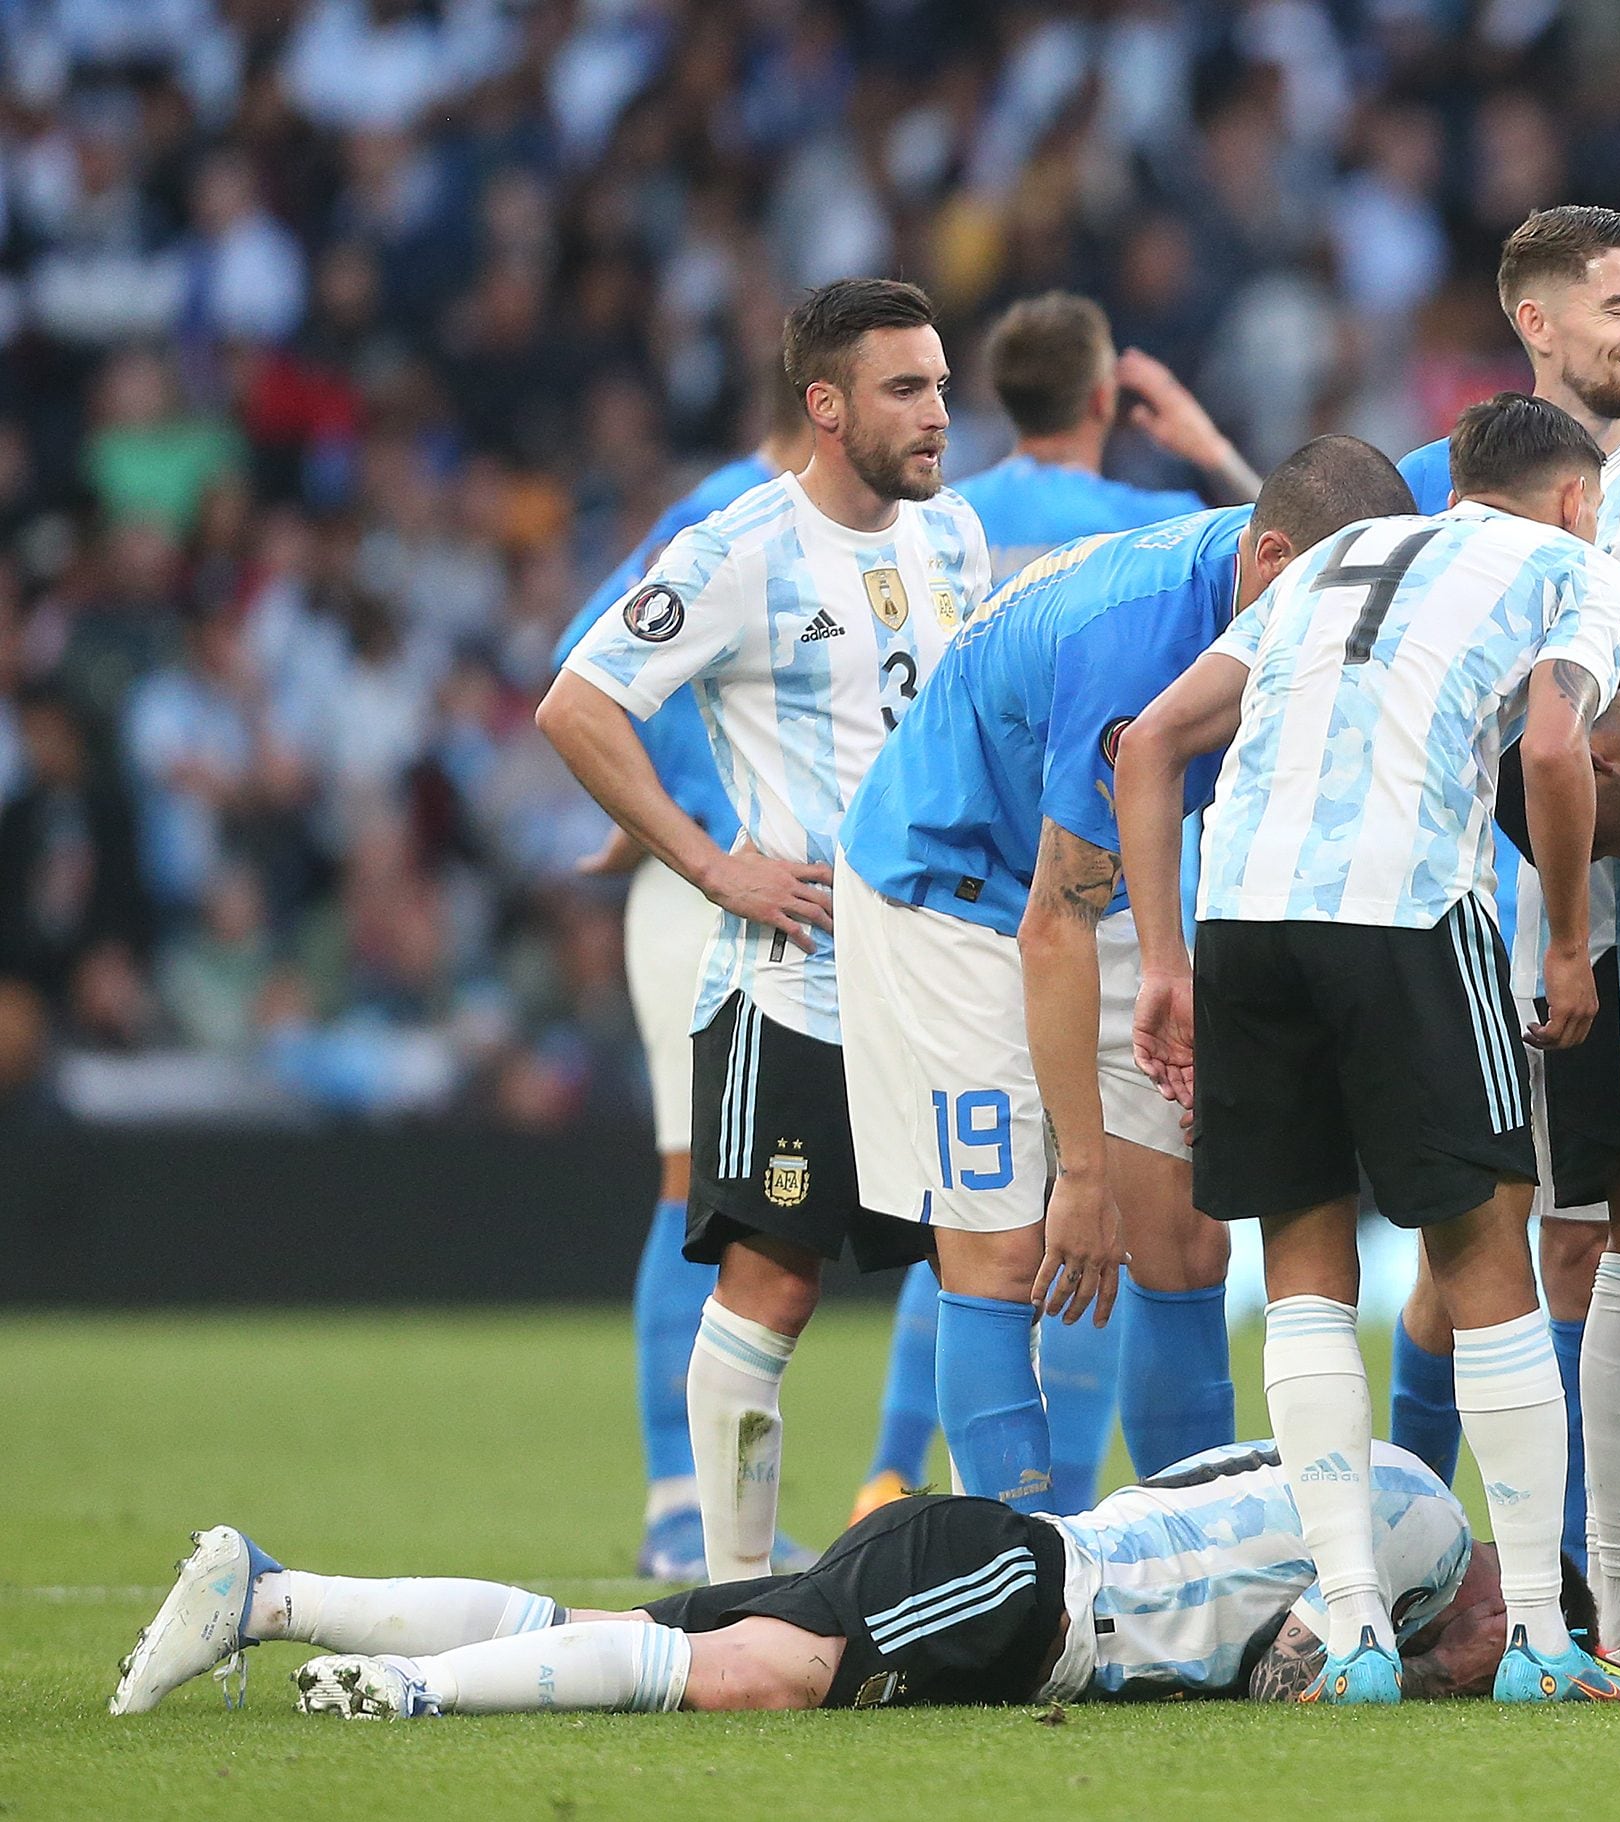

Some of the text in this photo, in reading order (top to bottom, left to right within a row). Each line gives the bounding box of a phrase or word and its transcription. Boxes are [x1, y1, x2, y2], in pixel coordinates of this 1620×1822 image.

[1309, 525, 1445, 665] 4
[800, 625, 846, 644] adidas
[931, 1088, 1014, 1192] 19
[774, 1168, 799, 1193] AFA
[1300, 1470, 1360, 1482] adidas
